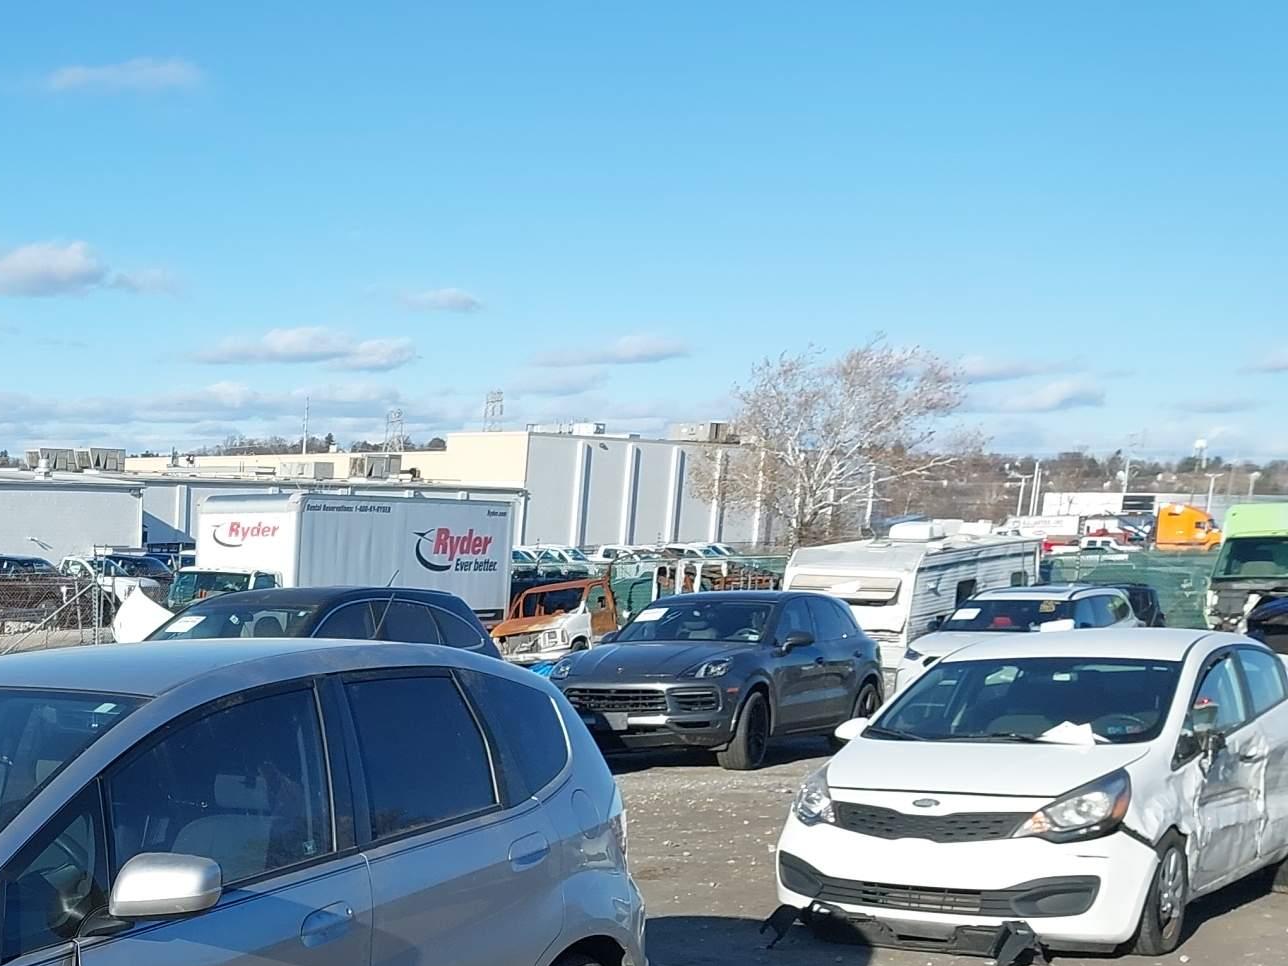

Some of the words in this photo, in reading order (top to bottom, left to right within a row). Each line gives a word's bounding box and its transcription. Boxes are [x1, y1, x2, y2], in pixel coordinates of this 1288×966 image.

[228, 521, 280, 542] Ryder
[432, 527, 493, 562] Ryder
[454, 558, 474, 572] Ever
